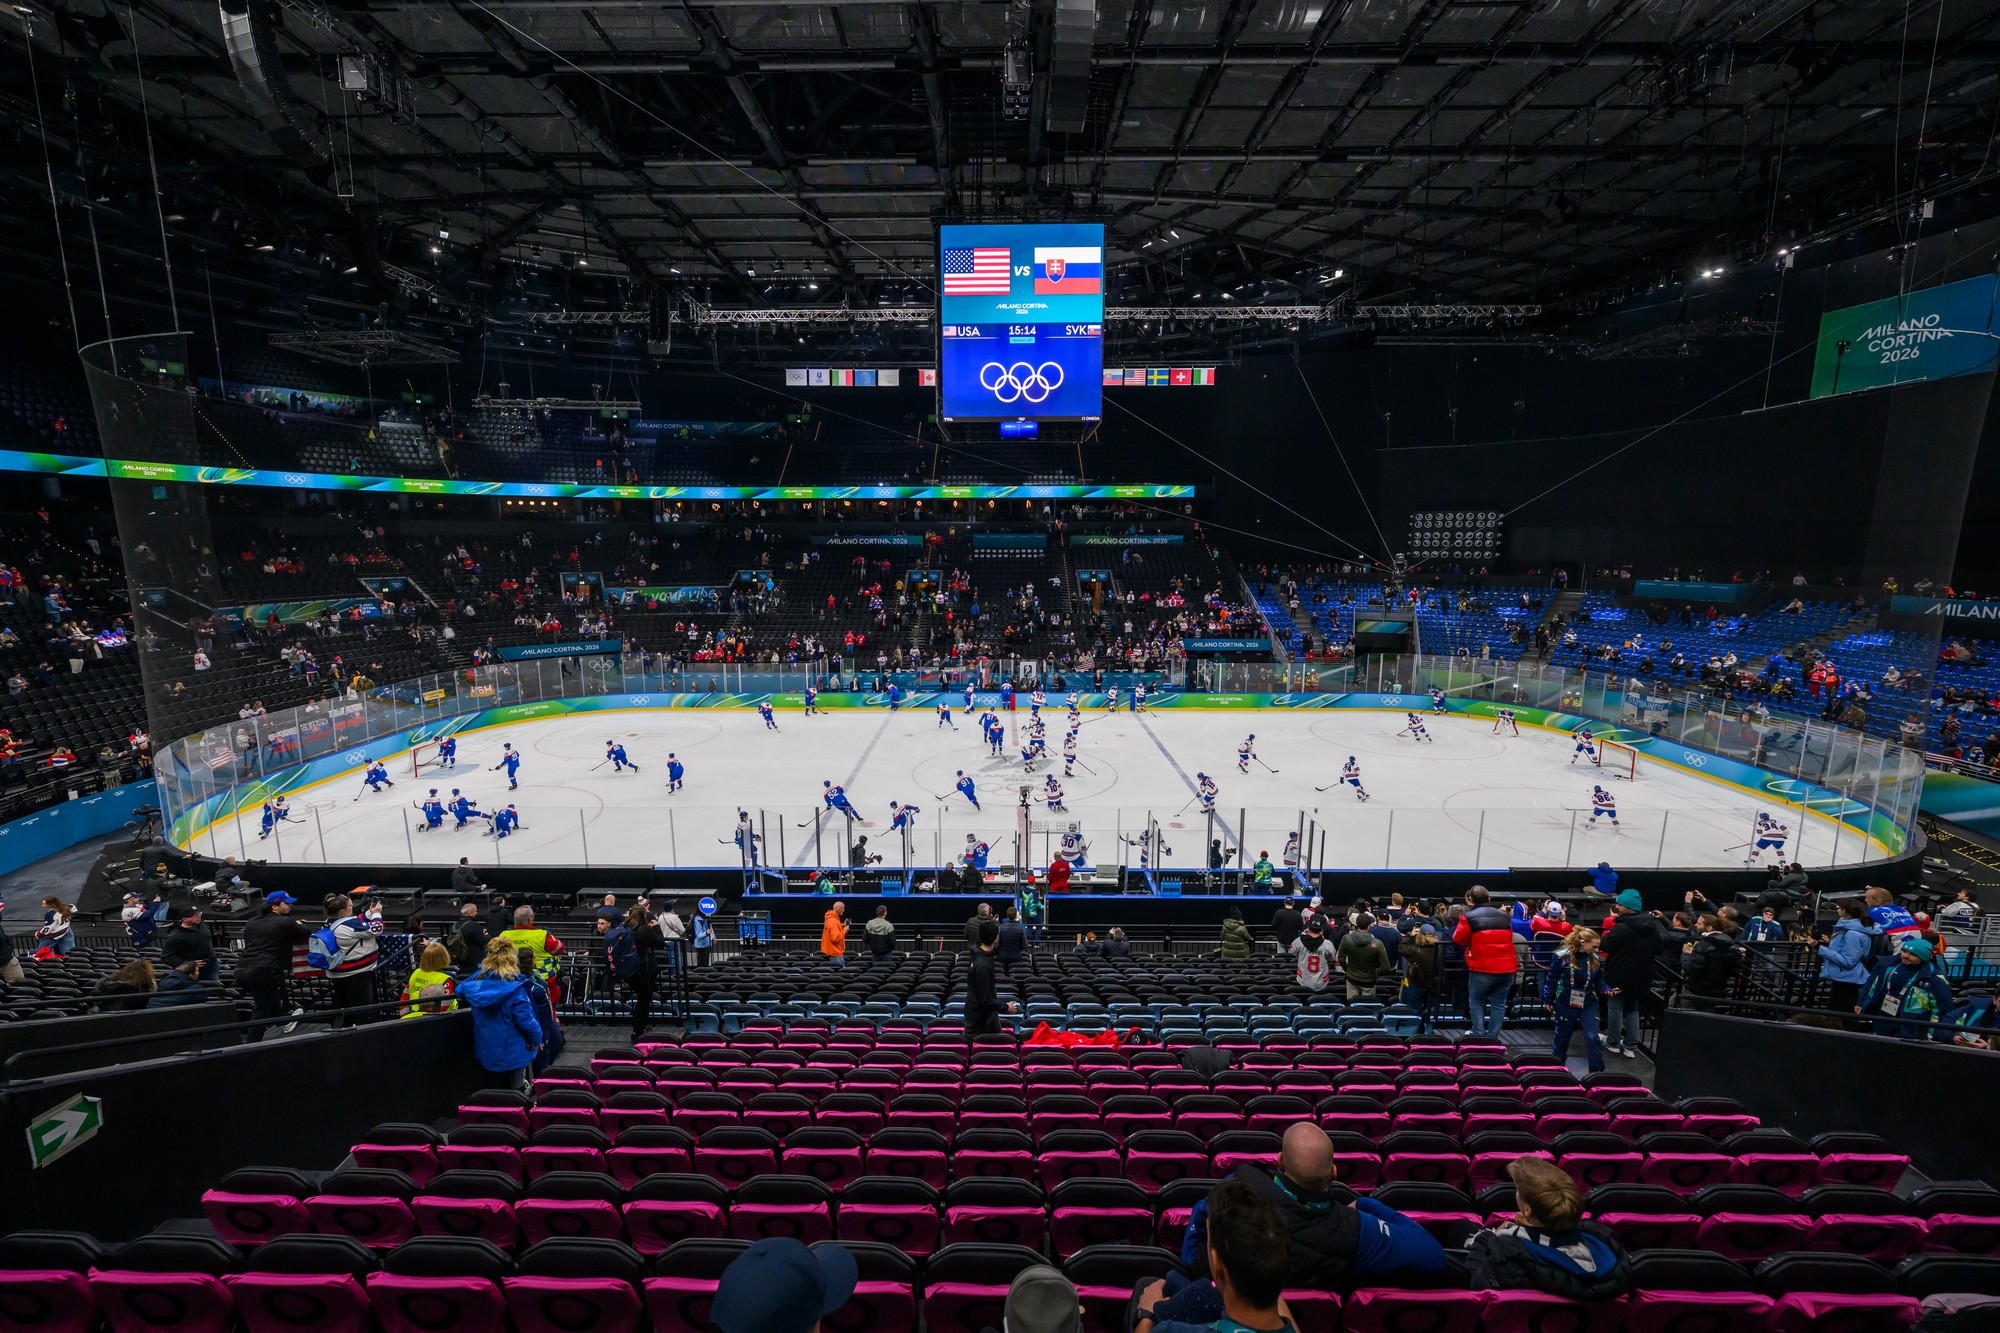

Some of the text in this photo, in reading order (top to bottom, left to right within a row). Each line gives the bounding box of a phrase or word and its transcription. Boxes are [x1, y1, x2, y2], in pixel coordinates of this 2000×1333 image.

[1014, 265, 1031, 276] VS
[957, 326, 981, 337] USA
[1009, 325, 1036, 335] 15:14
[1065, 325, 1087, 335] SVK
[1856, 314, 1940, 342] MILANO
[1868, 327, 1954, 352] CORTINA
[1880, 346, 1920, 364] 2026
[1924, 603, 2000, 620] MILAN
[521, 647, 552, 656] MILANO
[552, 646, 585, 654] CORTINA
[508, 706, 529, 714] MILANO
[960, 778, 970, 787] 91
[827, 788, 839, 800] 52
[1050, 784, 1058, 793] 10
[1762, 823, 1779, 831] 34
[1063, 838, 1075, 848] 30
[607, 946, 616, 969] USA
[1307, 955, 1320, 974] 8
